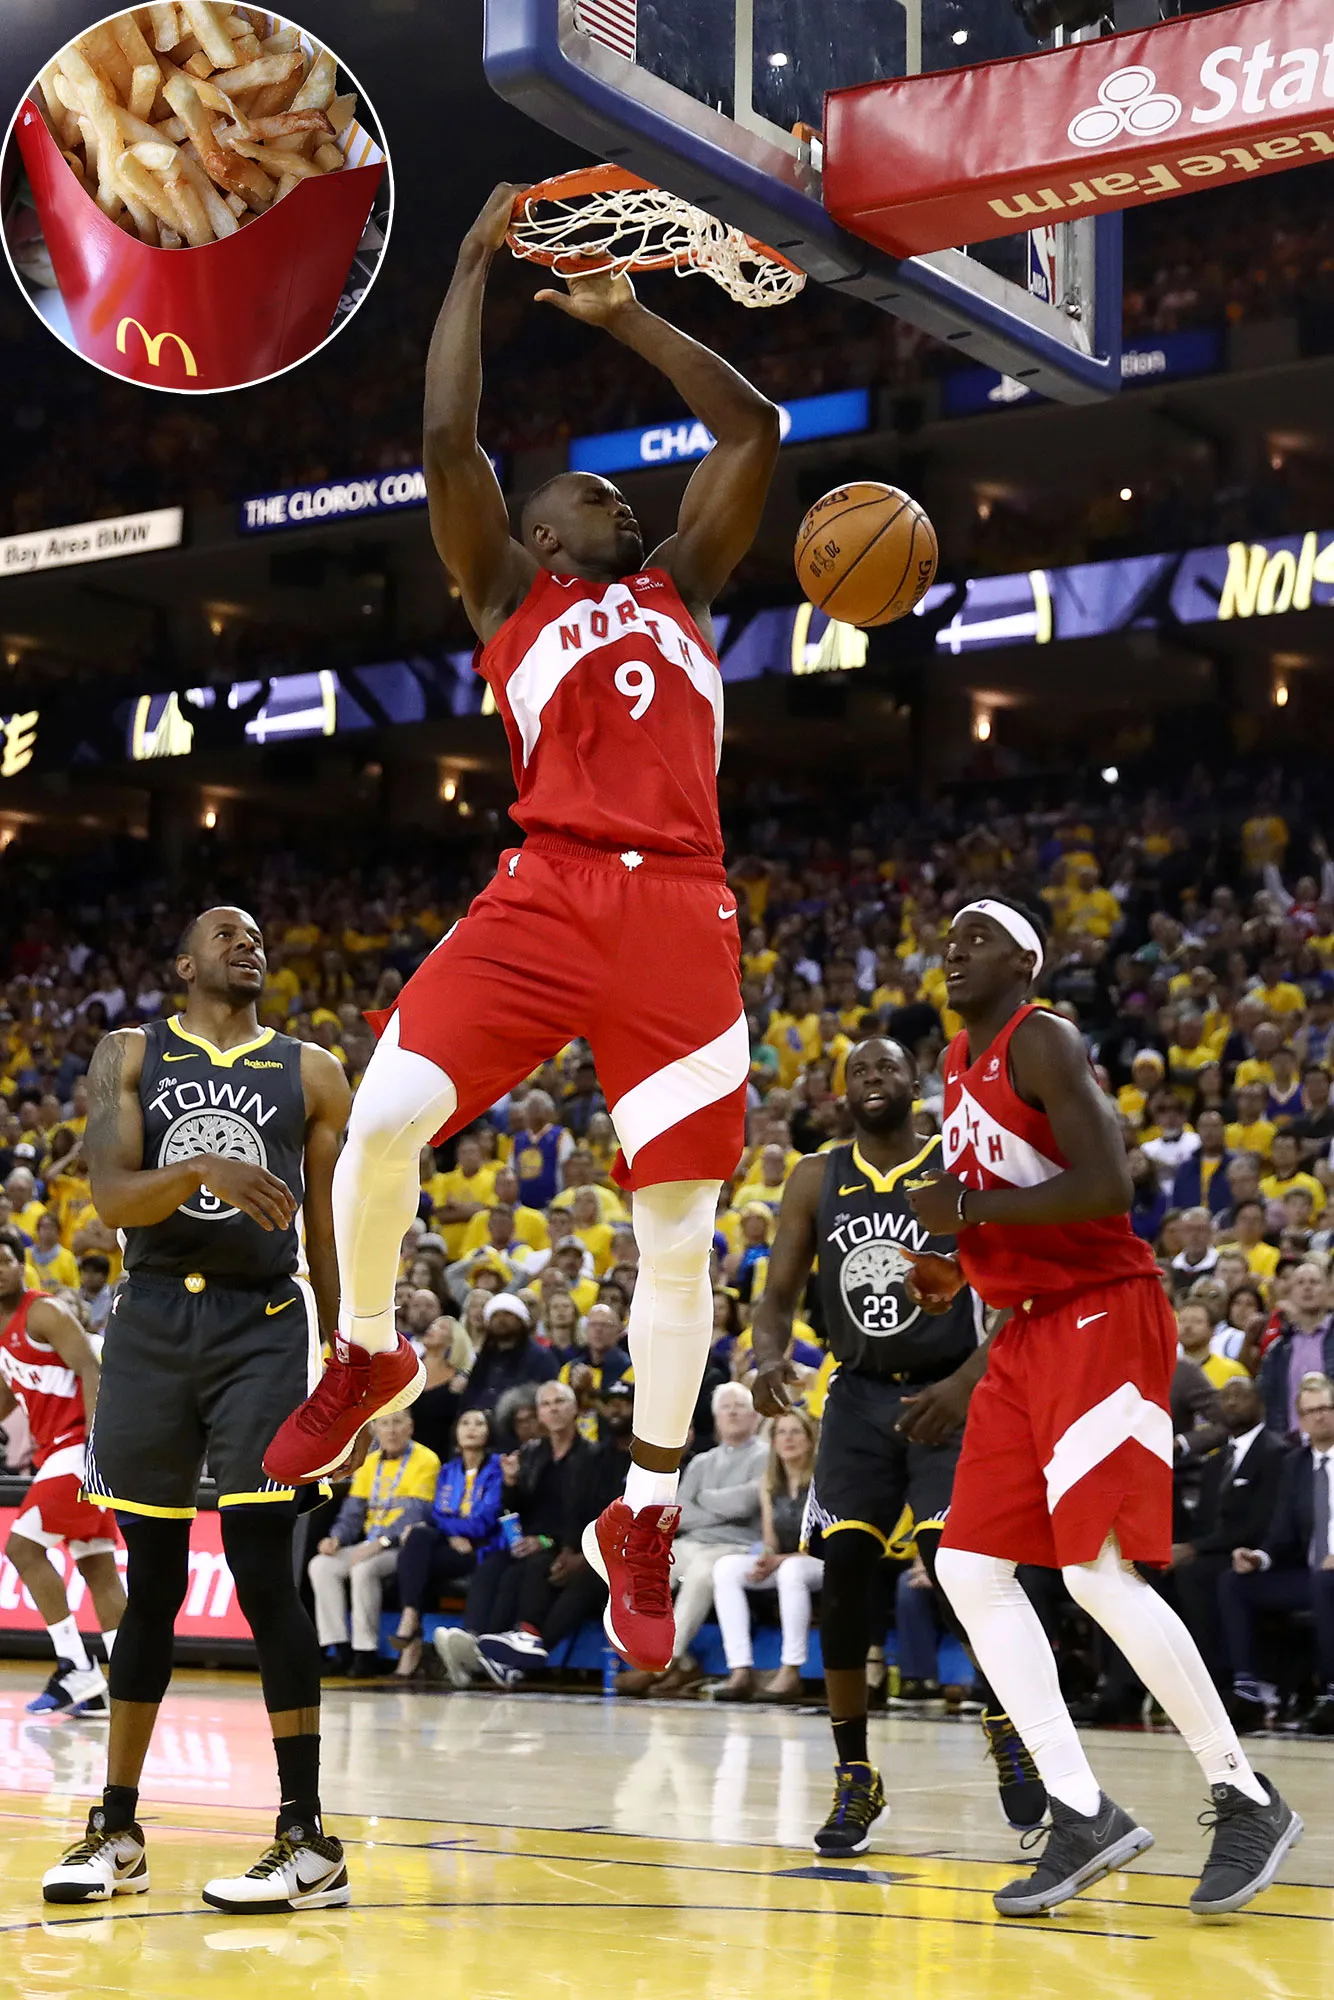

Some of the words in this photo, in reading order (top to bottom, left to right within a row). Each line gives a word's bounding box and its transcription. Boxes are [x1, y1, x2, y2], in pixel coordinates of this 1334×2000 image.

[245, 494, 288, 528] THE
[288, 480, 378, 520] CLOROX
[4, 544, 42, 571] Bay
[46, 536, 92, 557] Area
[95, 523, 152, 549] BMW
[558, 599, 696, 670] NORTH
[614, 660, 656, 721] 9
[157, 1077, 177, 1093] The
[243, 1058, 284, 1070] Rakuten
[149, 1080, 278, 1127] TOWN
[826, 1212, 930, 1253] TOWN
[862, 1295, 899, 1328] 23
